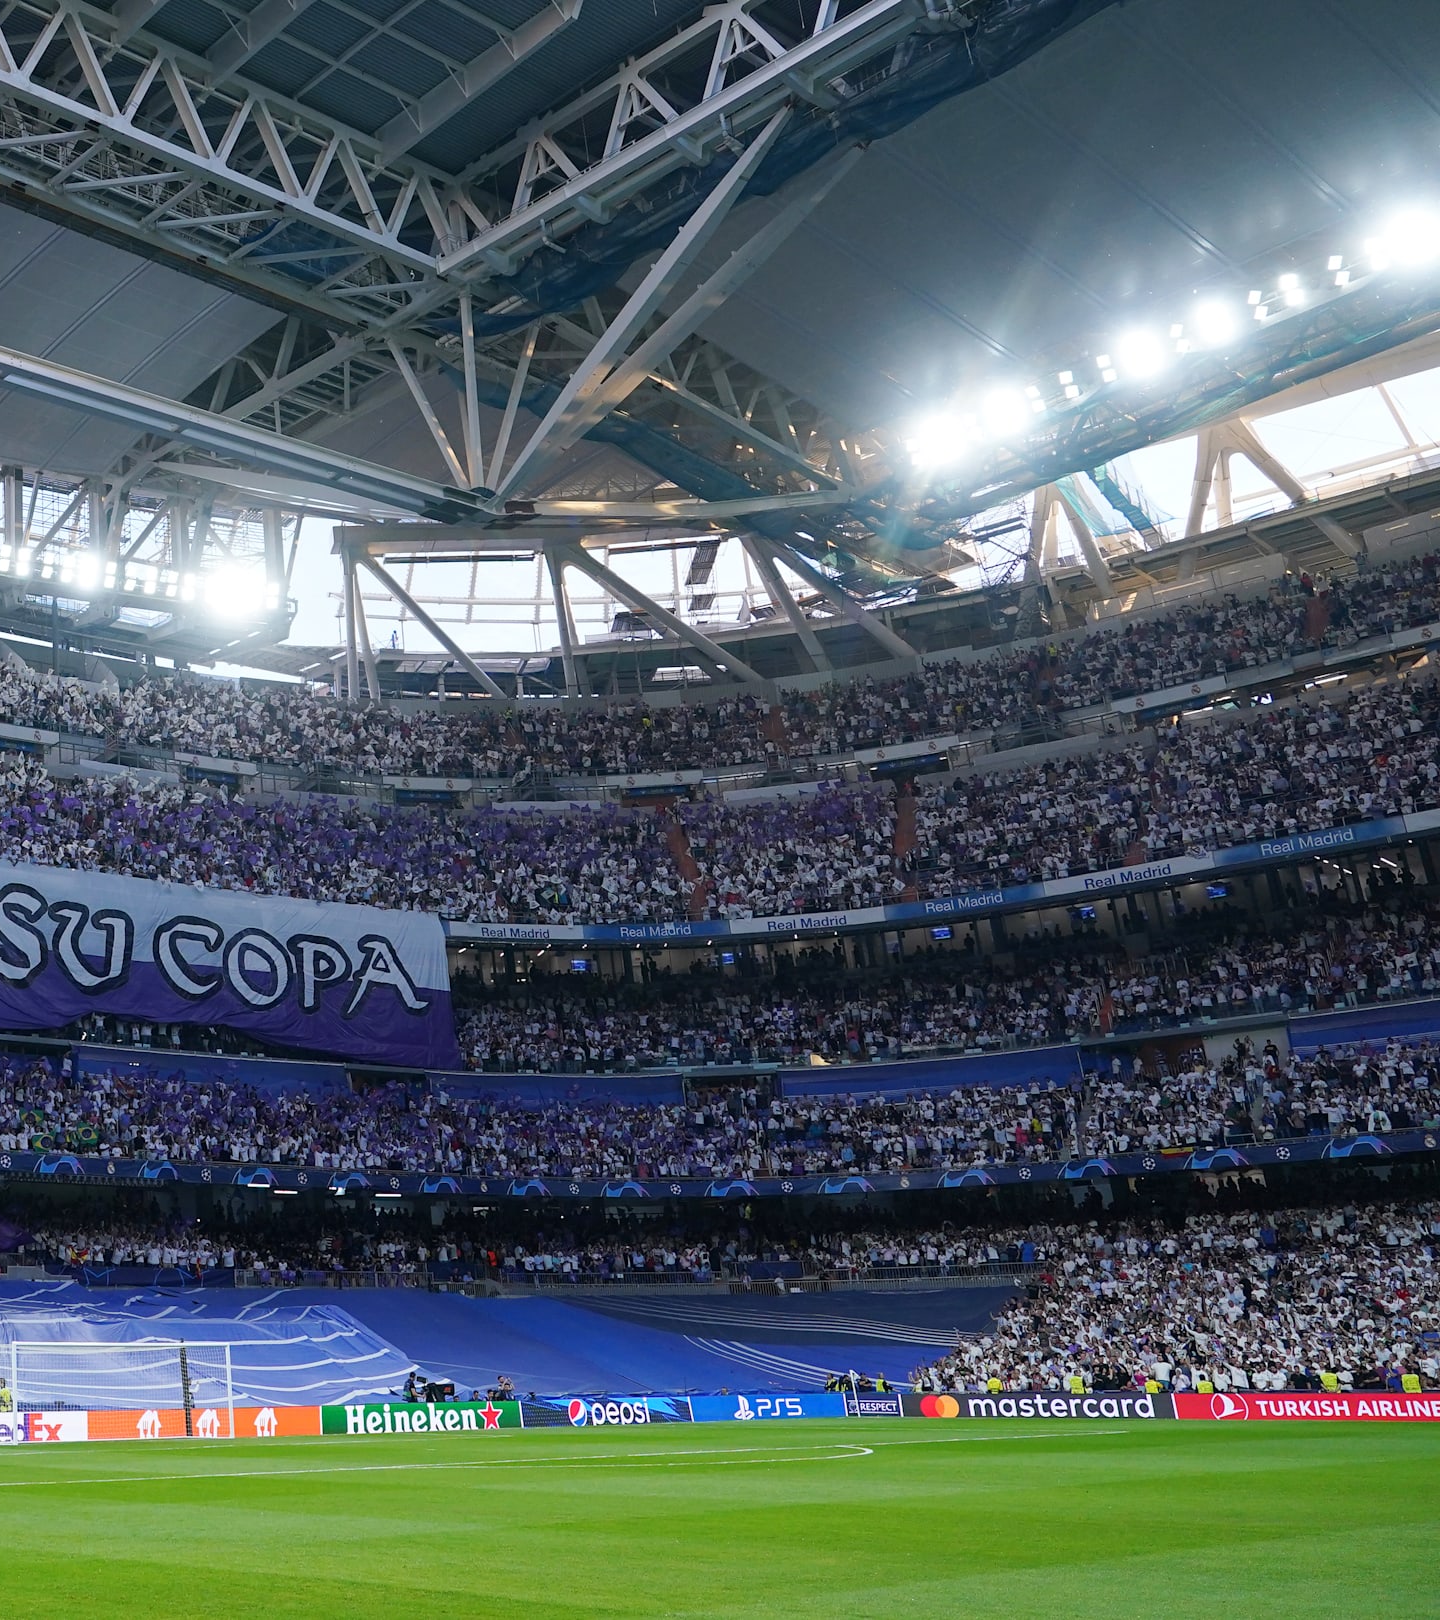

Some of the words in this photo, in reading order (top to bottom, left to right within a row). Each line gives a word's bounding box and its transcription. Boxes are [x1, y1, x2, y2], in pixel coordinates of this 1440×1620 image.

[1261, 841, 1295, 857] Real
[1298, 828, 1354, 851] Madrid
[1084, 875, 1117, 891] Real
[1121, 864, 1172, 885] Madrid
[925, 900, 953, 914] Real
[957, 891, 1003, 910] Madrid
[481, 926, 507, 938] Real
[510, 927, 550, 940] Madrid
[620, 926, 647, 938] Real
[650, 924, 691, 937] Madrid
[767, 919, 796, 932] Real
[799, 915, 848, 931] Madrid
[154, 915, 428, 1018] COPA
[591, 1397, 651, 1426] pepsi
[755, 1398, 803, 1417] PS5
[860, 1401, 898, 1412] RESPECT
[968, 1393, 1156, 1418] mastercard
[1256, 1400, 1351, 1417] TURKISH
[345, 1404, 479, 1434] Heineken
